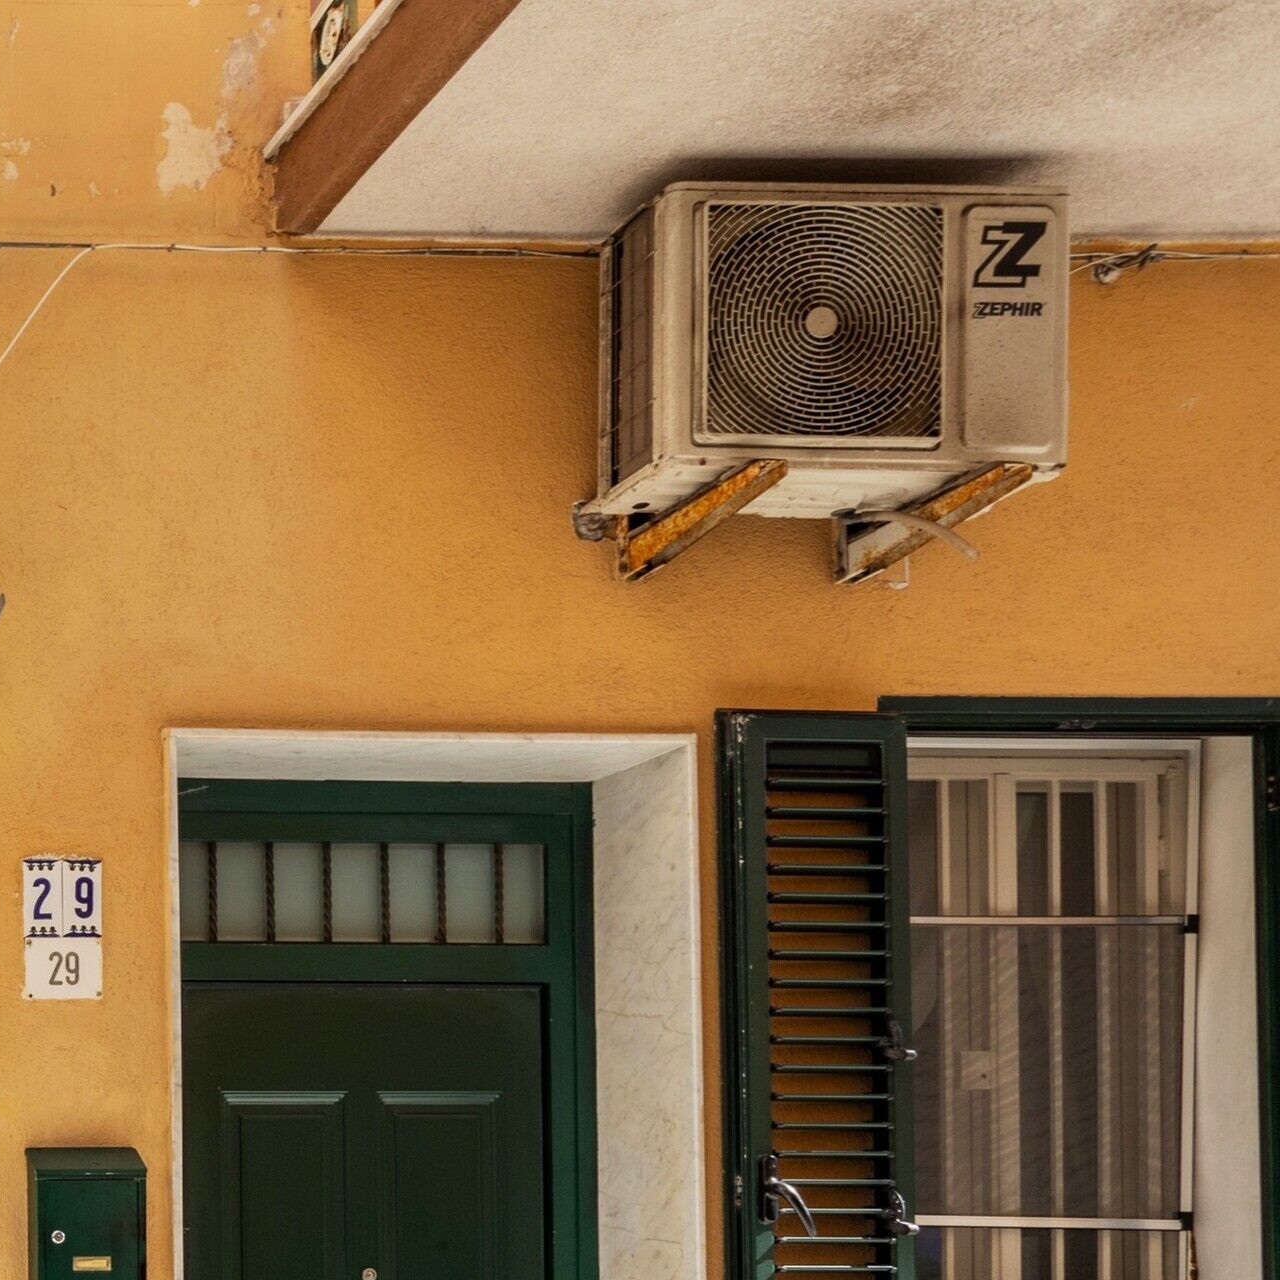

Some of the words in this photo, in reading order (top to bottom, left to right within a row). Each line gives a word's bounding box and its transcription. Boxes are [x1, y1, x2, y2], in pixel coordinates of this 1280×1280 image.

[972, 302, 1043, 319] ZEPHIR
[32, 876, 95, 920] 29
[48, 951, 81, 986] 29
